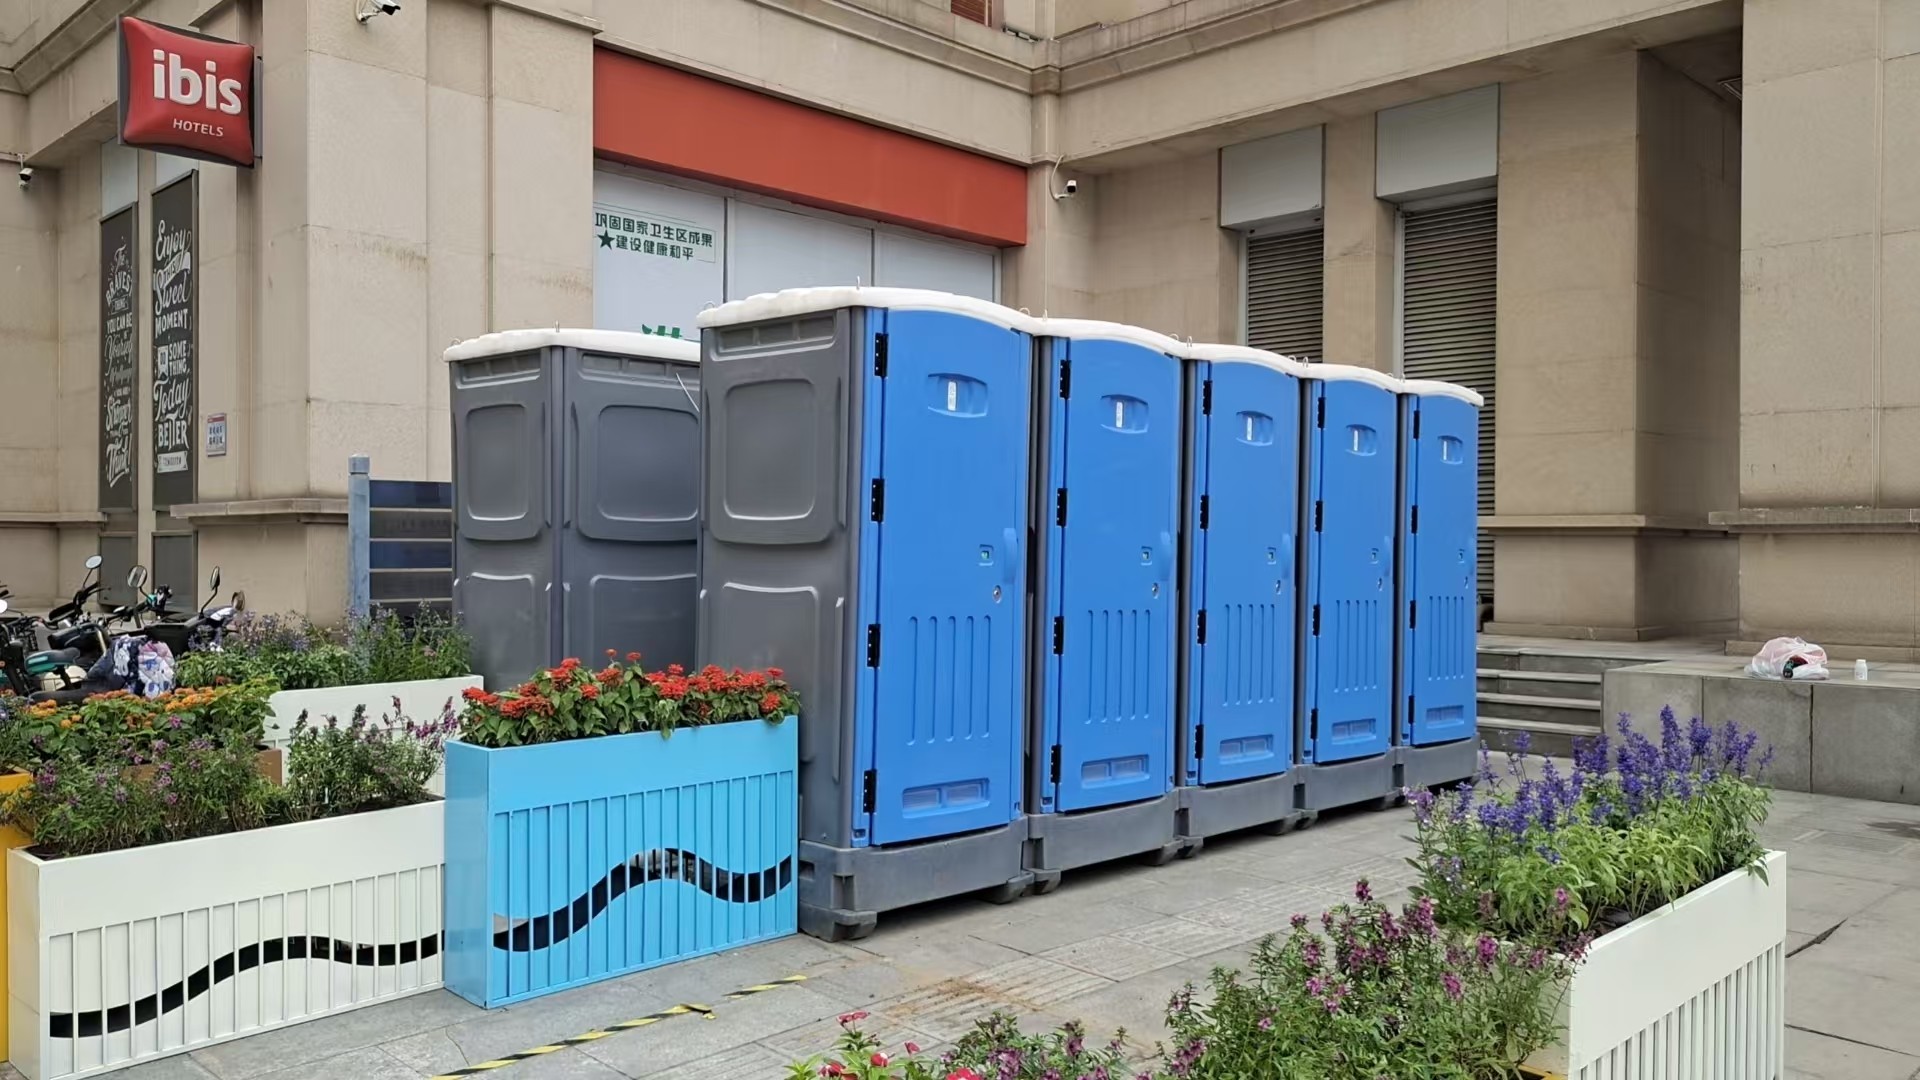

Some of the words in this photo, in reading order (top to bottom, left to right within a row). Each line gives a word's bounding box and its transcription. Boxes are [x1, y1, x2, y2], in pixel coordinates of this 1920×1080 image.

[153, 49, 242, 115] ibis
[173, 118, 224, 137] HOTELS
[156, 219, 190, 269] Enjoy
[595, 212, 713, 248] 巩固国家卫生区成果
[616, 234, 694, 261] 建设健康和平
[155, 269, 190, 316] Sweet
[155, 308, 188, 339] MOMENT
[168, 340, 187, 360] SOME
[153, 377, 189, 421] Today
[158, 409, 189, 451] BETTER
